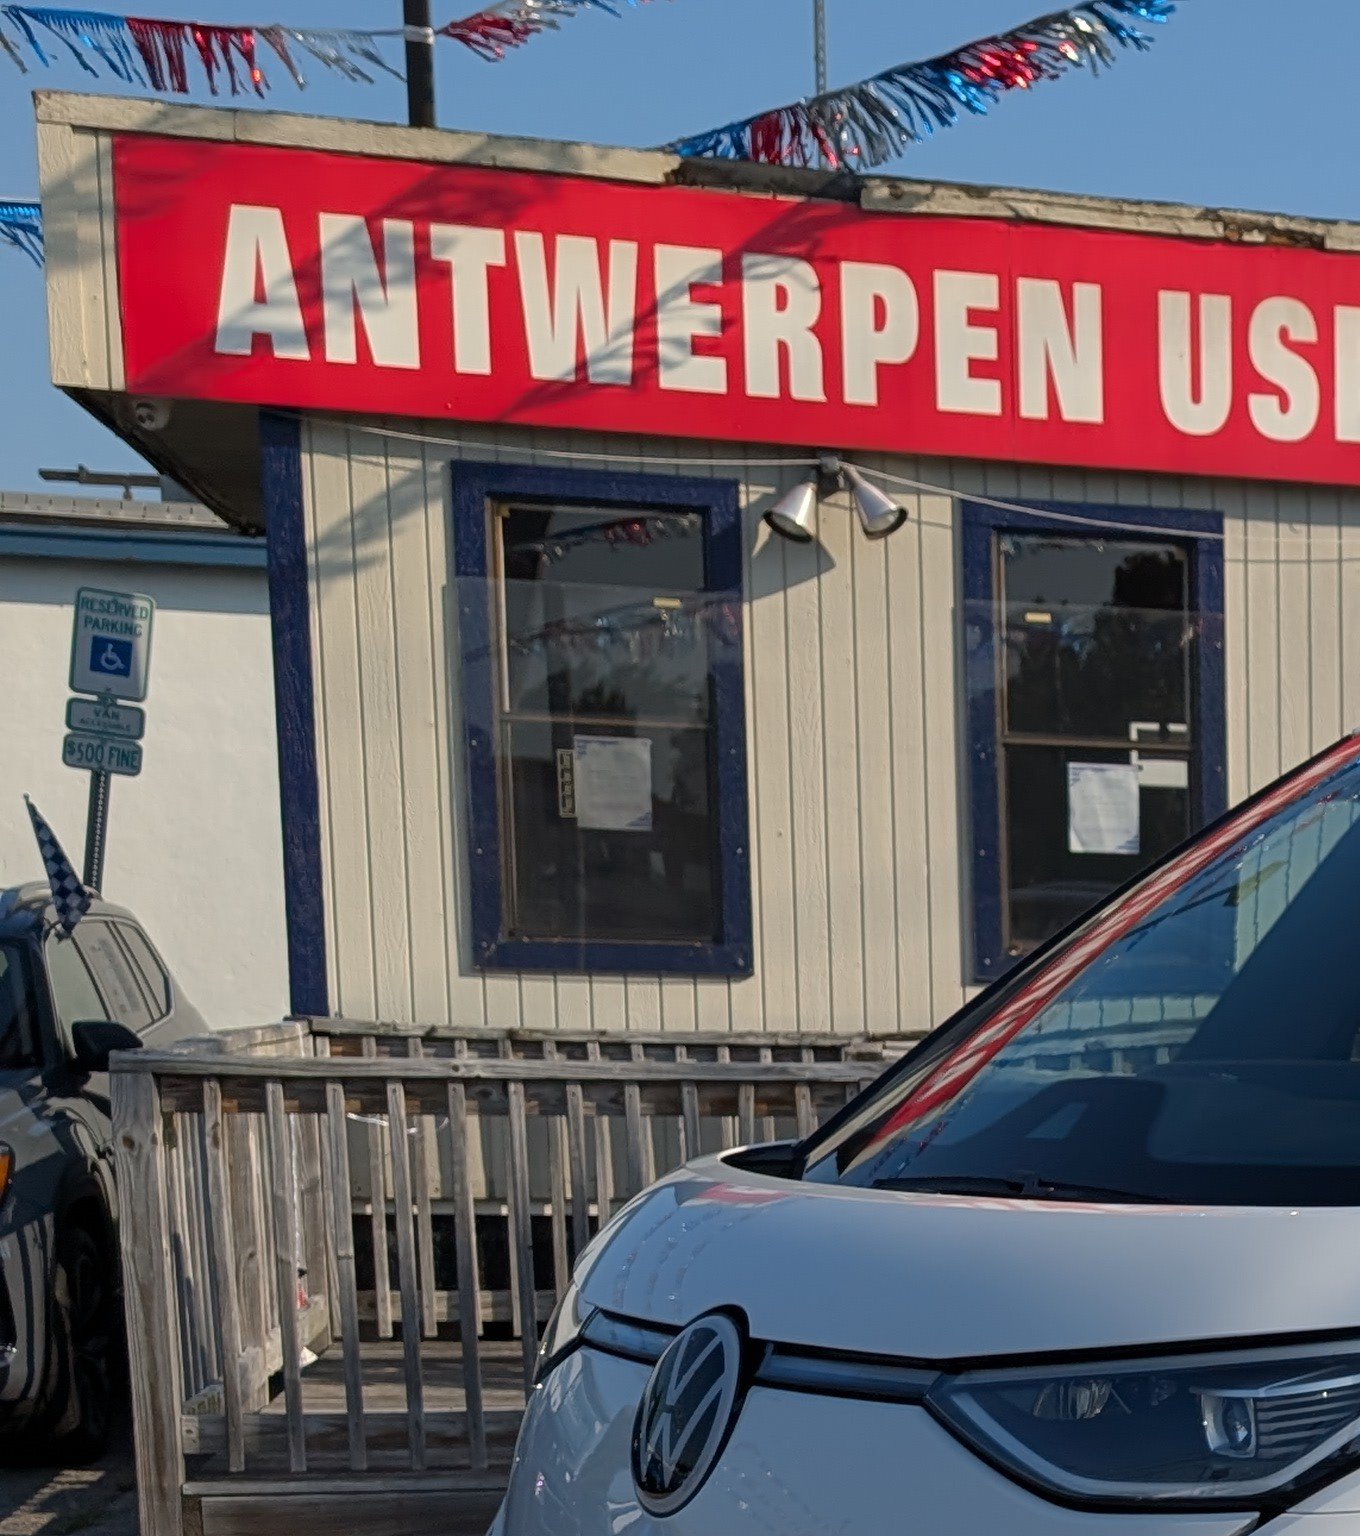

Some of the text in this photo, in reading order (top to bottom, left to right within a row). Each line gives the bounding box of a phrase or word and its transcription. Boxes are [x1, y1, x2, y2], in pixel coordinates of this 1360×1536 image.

[213, 202, 1105, 425] ANTWERPEN
[79, 596, 149, 621] RESERVED
[83, 614, 143, 637] PARKING
[94, 709, 121, 721] VAN
[67, 739, 139, 769] $500 FINE
